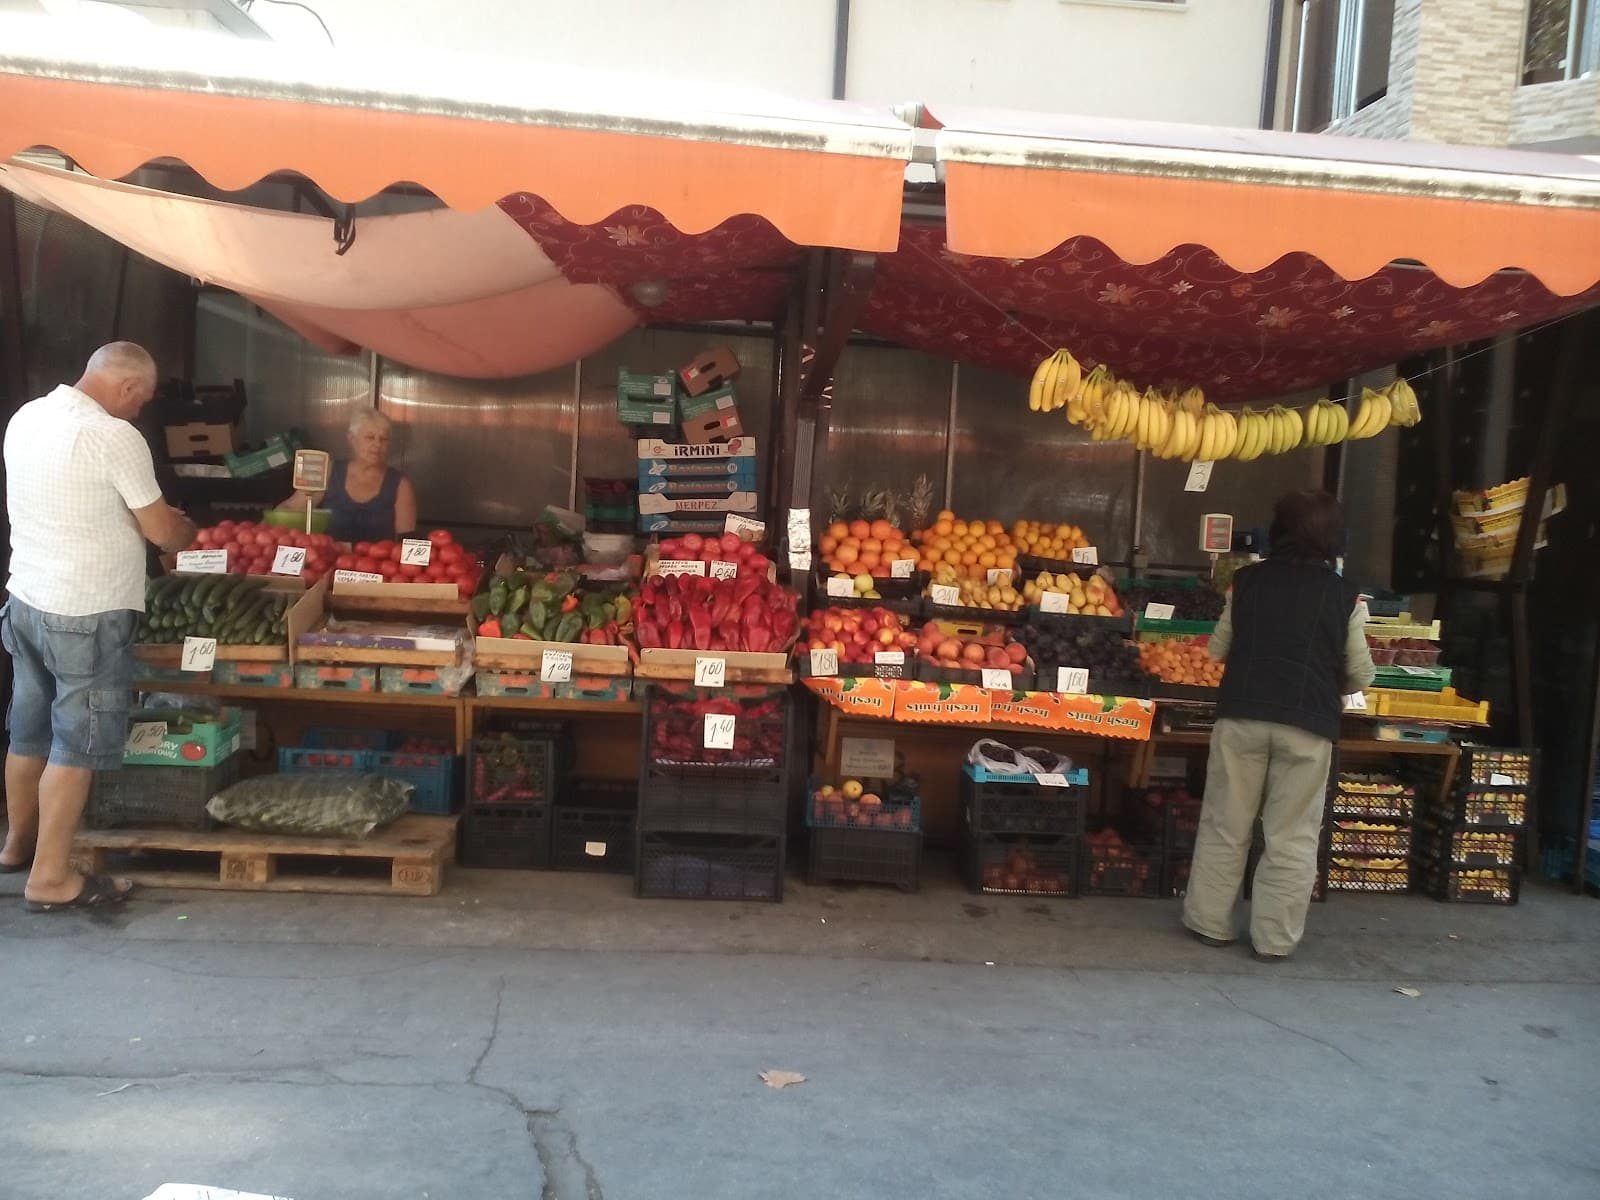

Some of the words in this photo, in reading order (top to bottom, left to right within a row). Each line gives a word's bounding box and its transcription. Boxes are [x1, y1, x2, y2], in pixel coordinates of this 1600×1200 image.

[849, 696, 882, 707] fresh
[905, 703, 942, 713] fruits
[945, 703, 980, 713] fresh
[1016, 706, 1049, 718] fresh
[1067, 710, 1103, 724] fruits
[1107, 716, 1141, 729] fresh
